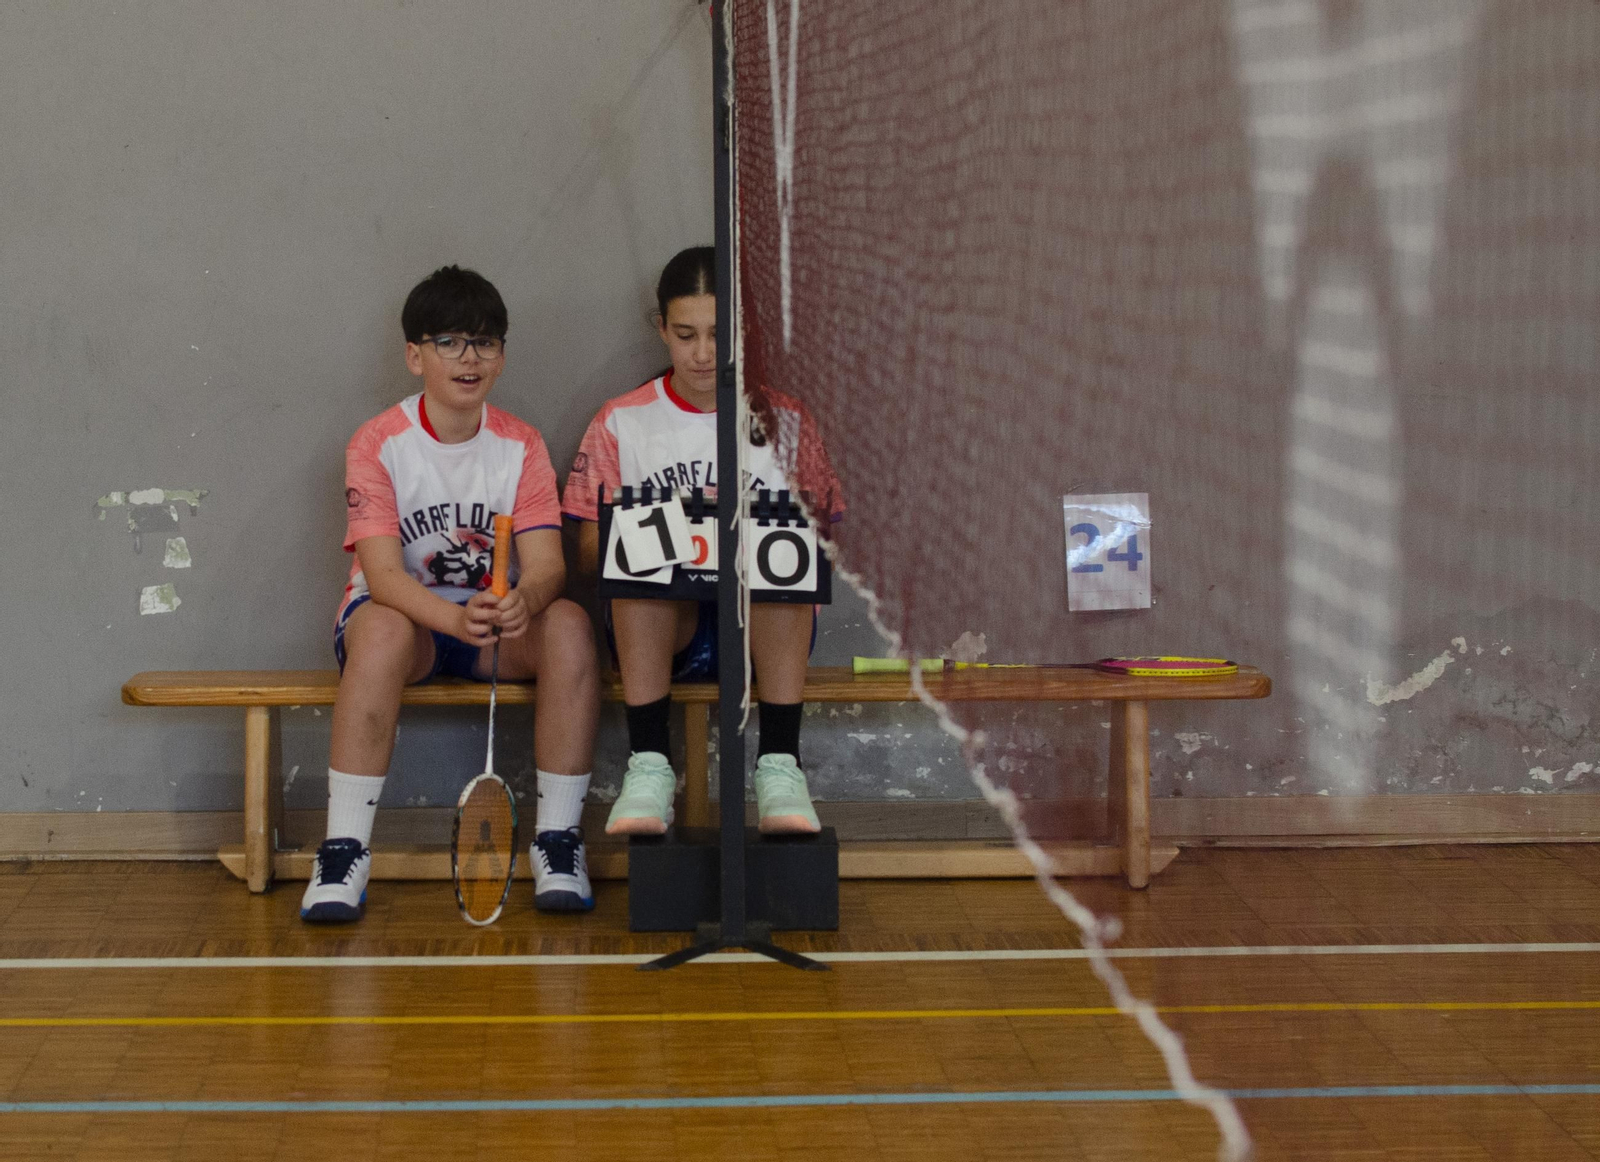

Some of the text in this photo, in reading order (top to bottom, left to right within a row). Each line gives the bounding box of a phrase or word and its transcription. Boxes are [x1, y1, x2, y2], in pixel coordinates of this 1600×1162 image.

[638, 507, 677, 561] 1
[757, 530, 810, 587] 0
[1070, 523, 1143, 573] 24
